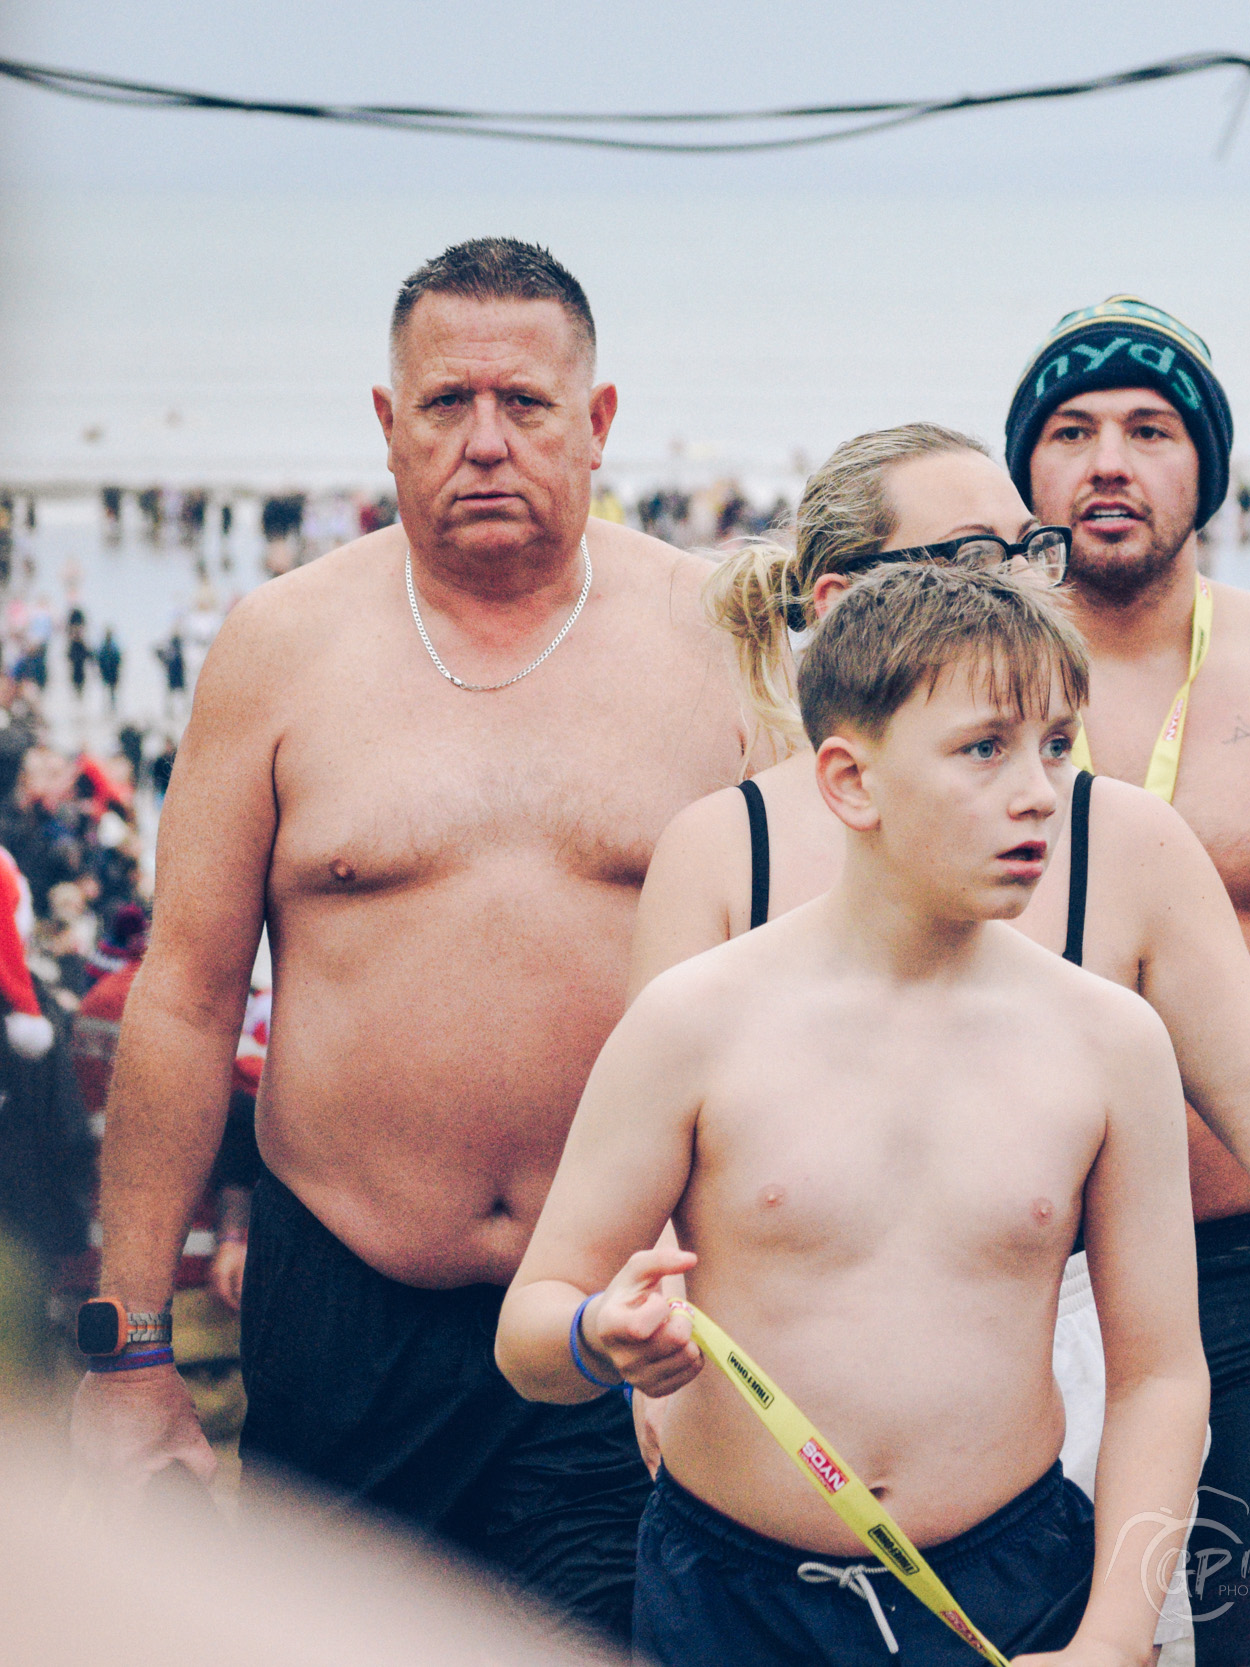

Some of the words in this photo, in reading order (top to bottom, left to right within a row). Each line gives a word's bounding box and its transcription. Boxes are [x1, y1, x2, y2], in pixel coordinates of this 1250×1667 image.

[730, 1355, 770, 1406] TRUEFORM
[802, 1440, 845, 1493] NYDS
[873, 1526, 915, 1574] TRUEFORM
